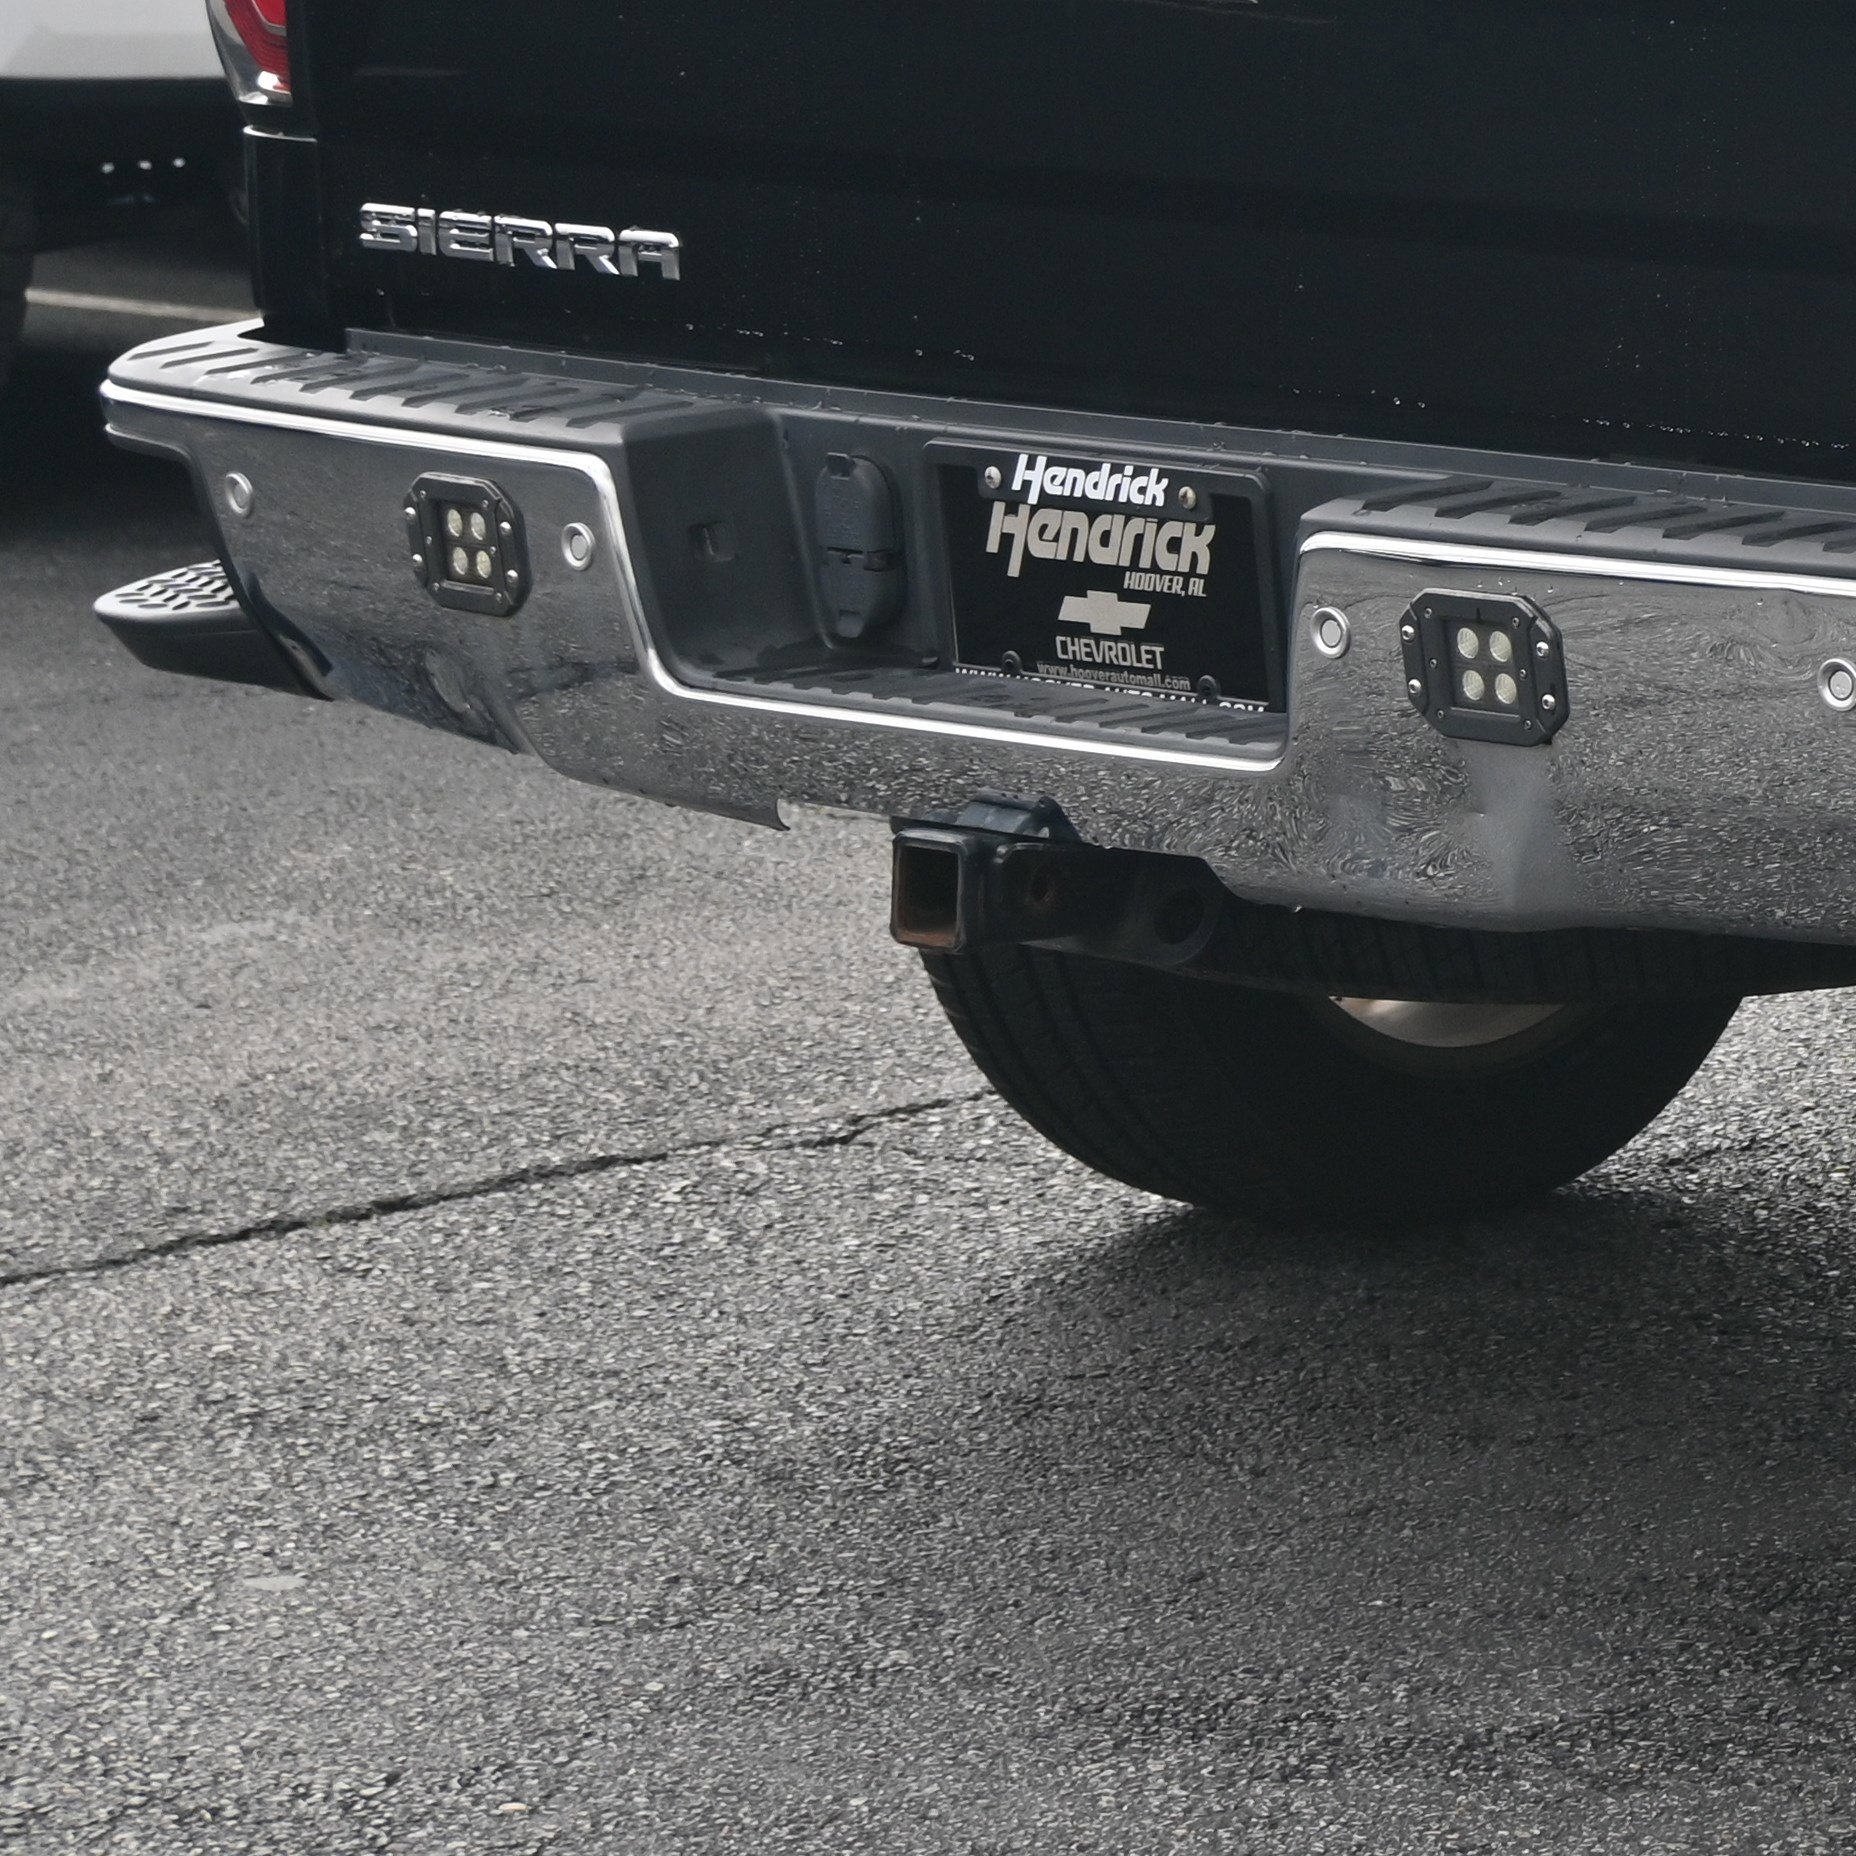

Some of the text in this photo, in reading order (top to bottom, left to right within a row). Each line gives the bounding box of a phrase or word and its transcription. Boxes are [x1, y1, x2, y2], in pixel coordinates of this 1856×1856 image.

[360, 202, 682, 282] SIERRA
[1011, 453, 1170, 507] Hendrick
[985, 501, 1216, 578] Hendrick
[1123, 571, 1208, 598] HOOVER, AL
[1055, 635, 1165, 671] CHEVROLET
[1036, 660, 1192, 692] www.hooverautomall.com
